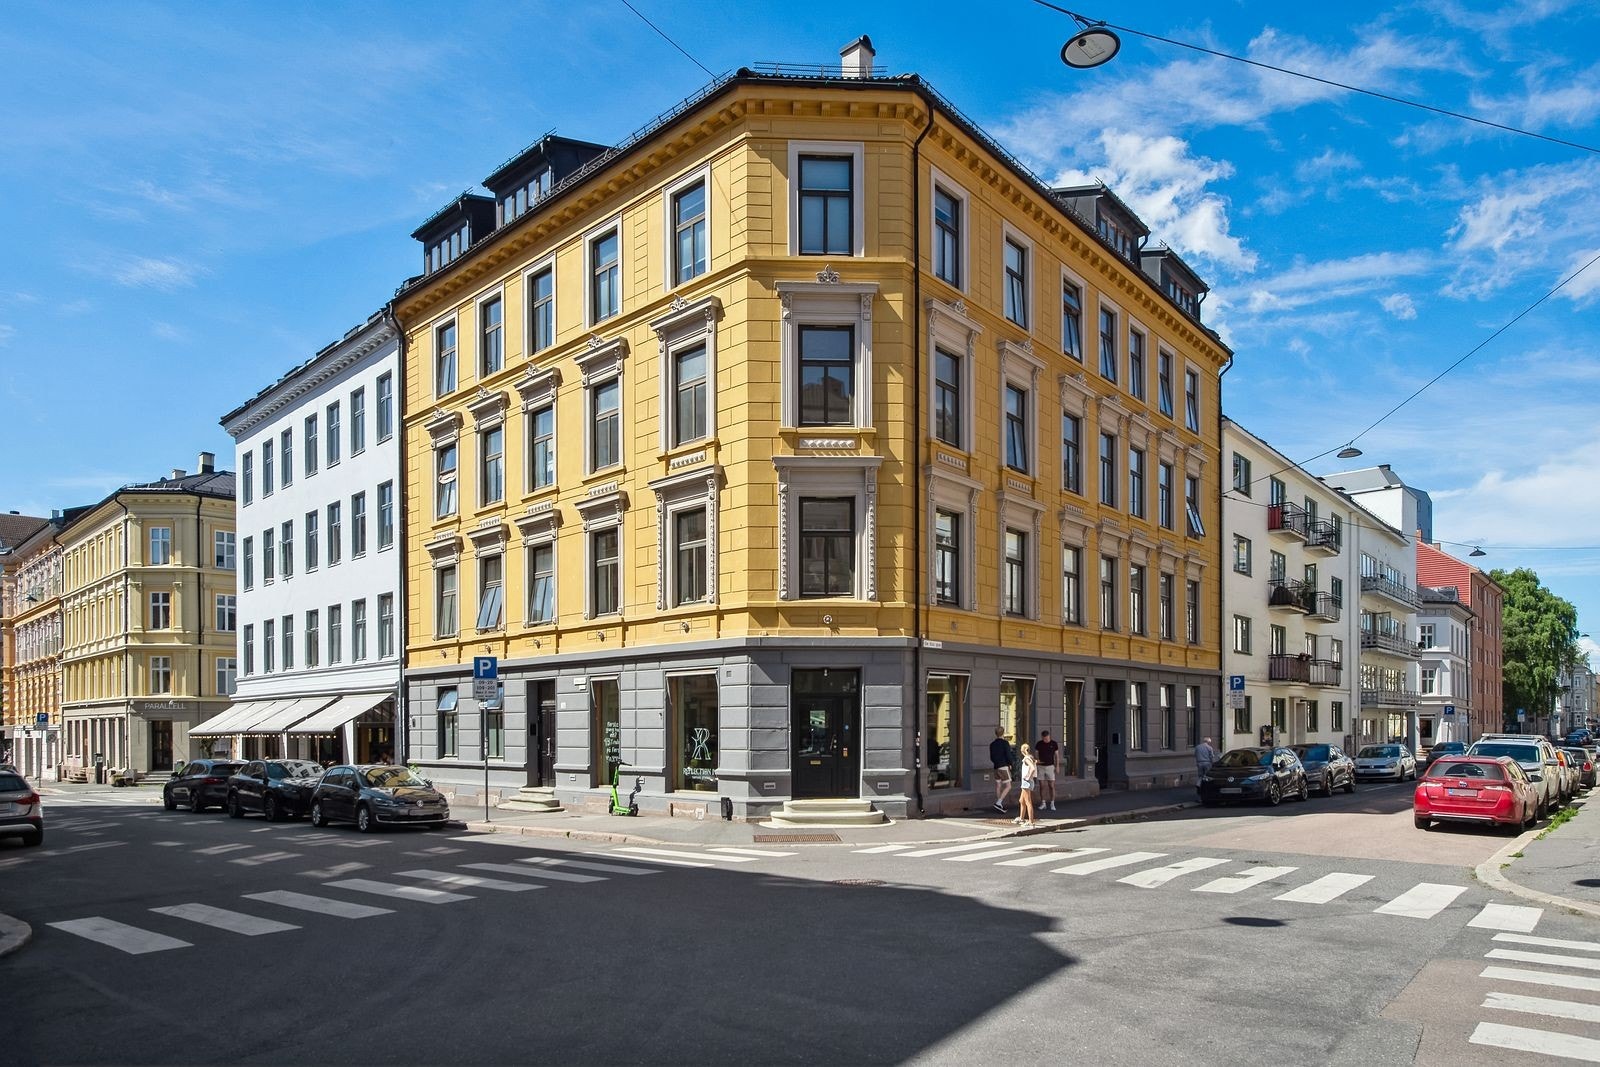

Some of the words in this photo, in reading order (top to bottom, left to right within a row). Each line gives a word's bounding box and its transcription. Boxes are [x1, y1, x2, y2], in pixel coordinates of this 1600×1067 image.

[480, 660, 492, 676] P
[1233, 677, 1241, 688] P
[40, 714, 46, 722] P
